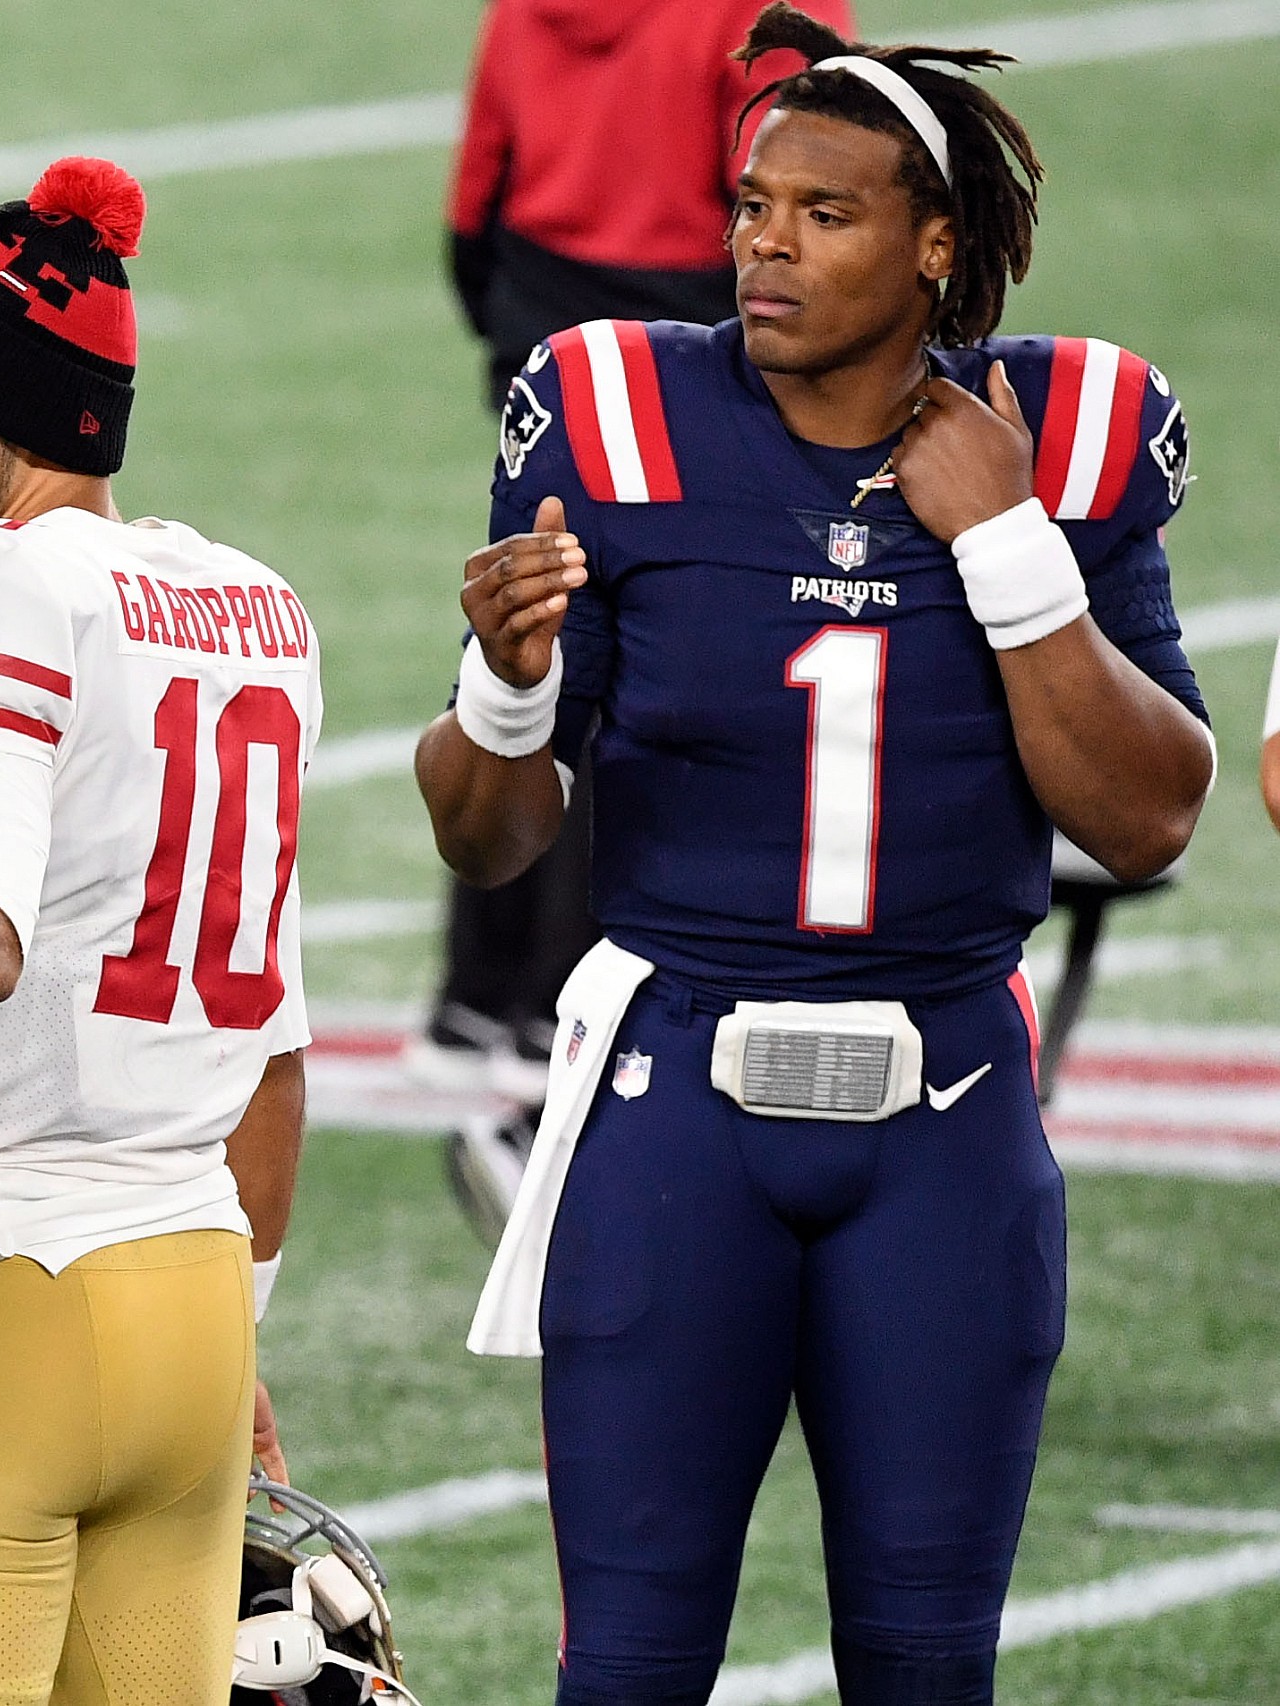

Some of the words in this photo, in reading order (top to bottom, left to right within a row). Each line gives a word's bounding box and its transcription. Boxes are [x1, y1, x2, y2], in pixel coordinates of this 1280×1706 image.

[791, 576, 898, 607] PATRIOTS
[835, 542, 861, 560] NFL
[110, 570, 308, 658] GAROPPOLO
[784, 623, 888, 935] 1
[92, 677, 301, 1030] 10
